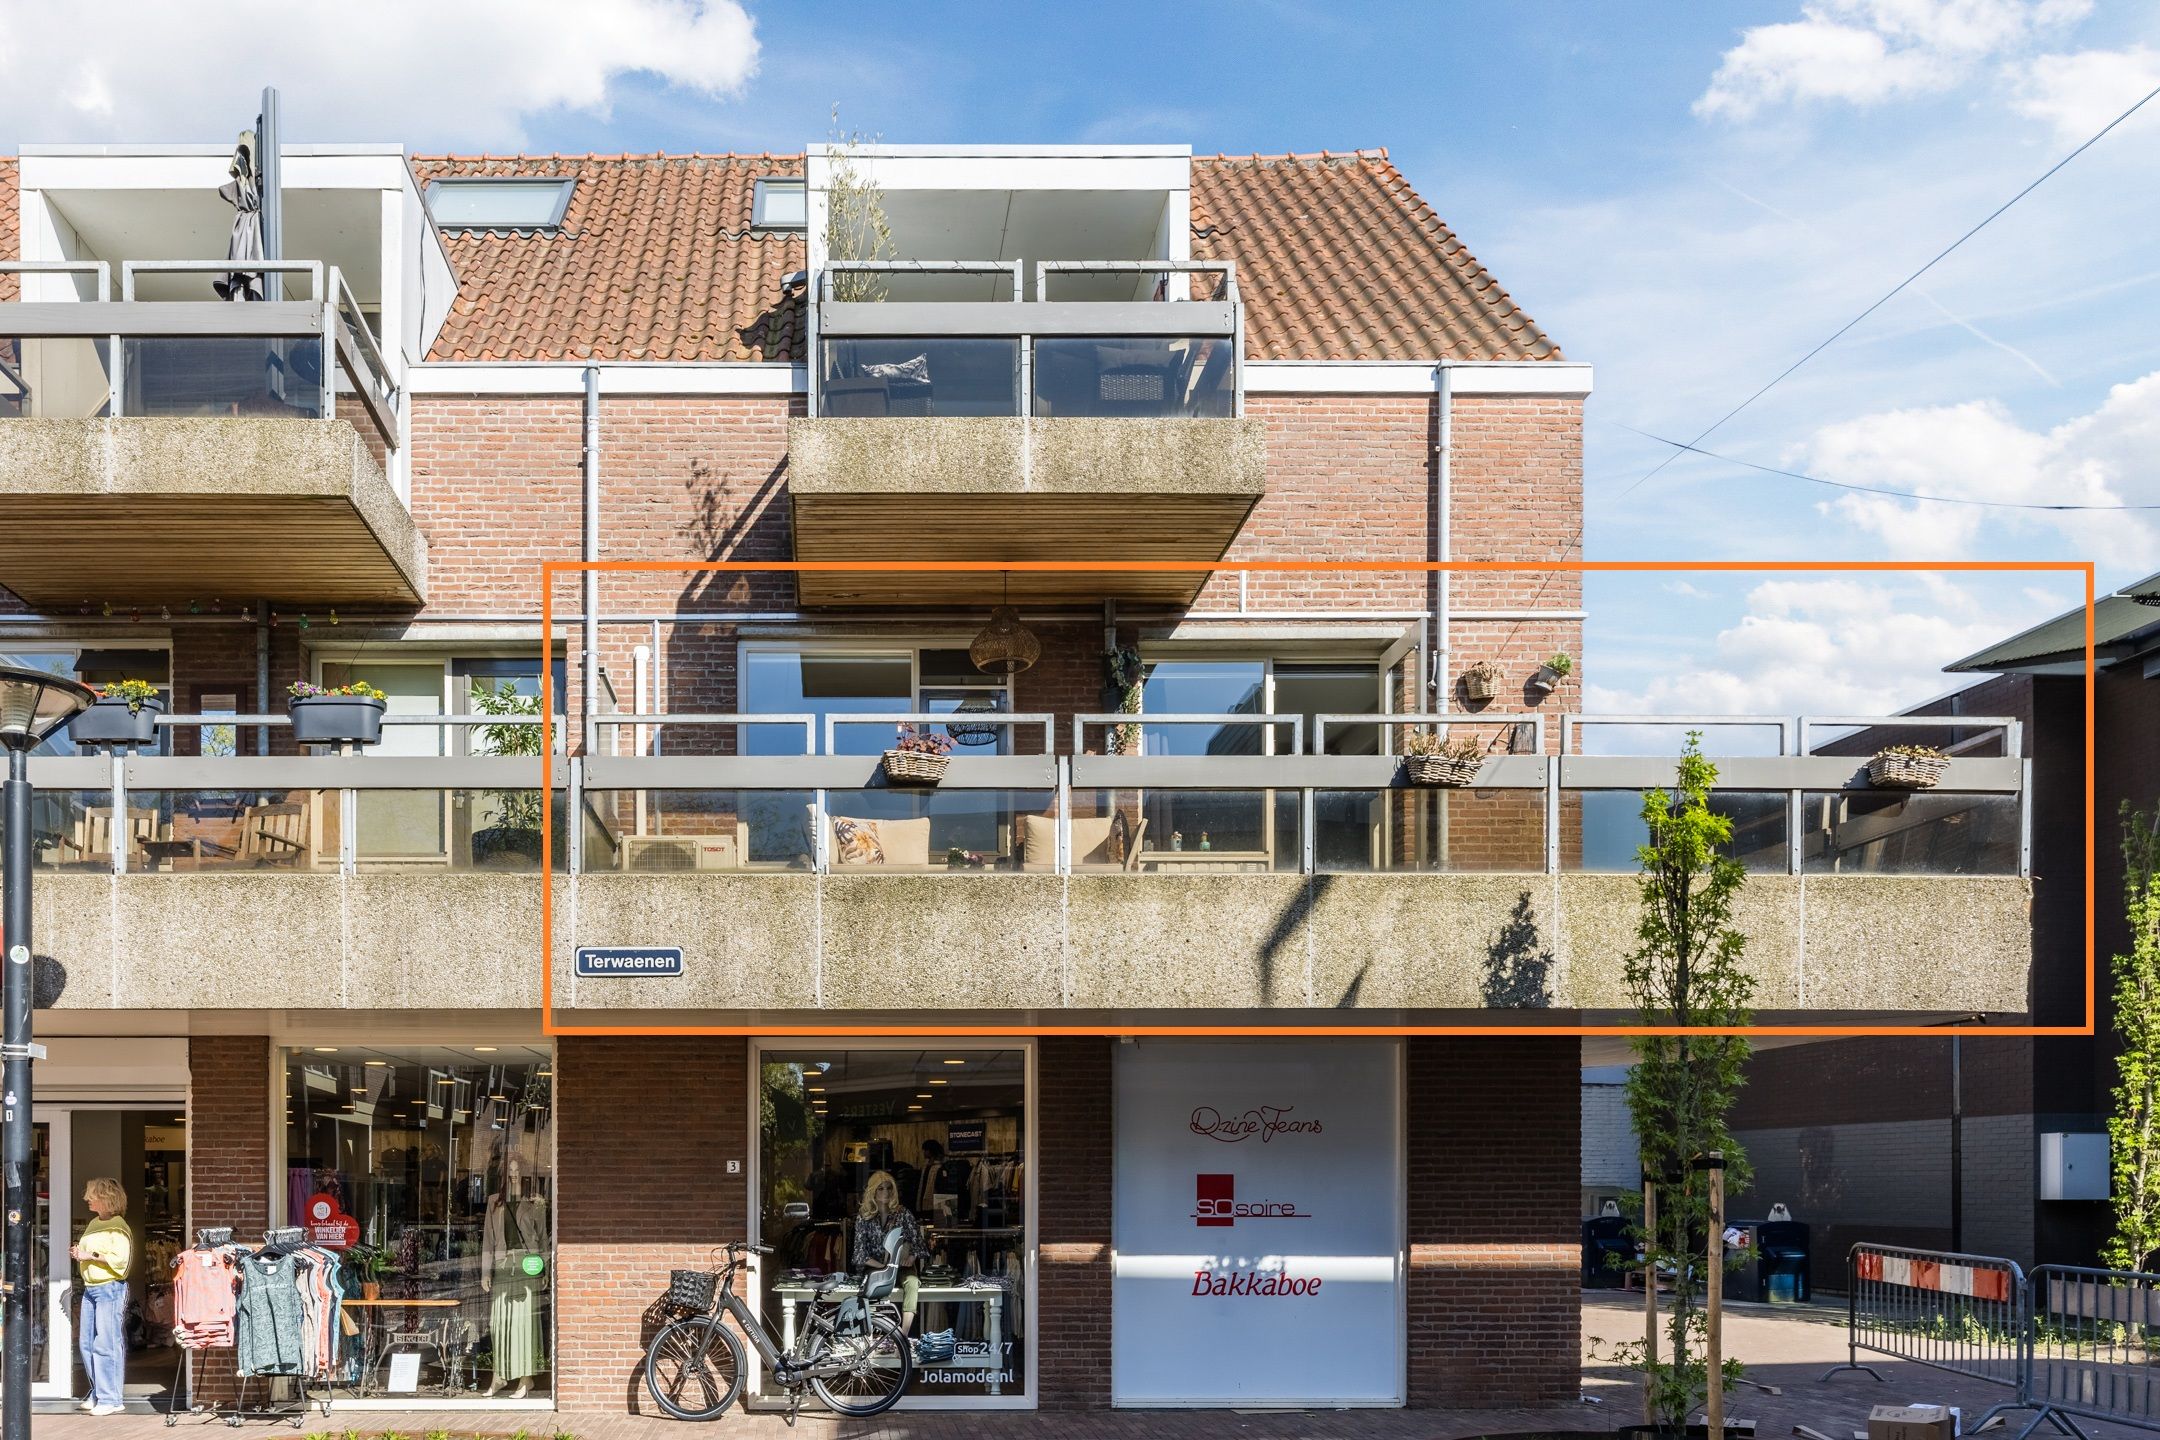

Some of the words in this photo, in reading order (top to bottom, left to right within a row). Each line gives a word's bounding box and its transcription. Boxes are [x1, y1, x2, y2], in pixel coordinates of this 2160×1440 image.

[585, 954, 675, 968] Terwaenen
[7, 1112, 11, 1120] 1
[1256, 1105, 1323, 1143] Jeans
[730, 1161, 736, 1171] 3
[1191, 1271, 1322, 1296] Bakkaboe
[957, 1345, 979, 1354] Shop
[979, 1342, 1013, 1355] 24/7
[920, 1368, 1014, 1383] Jolamode.nl
